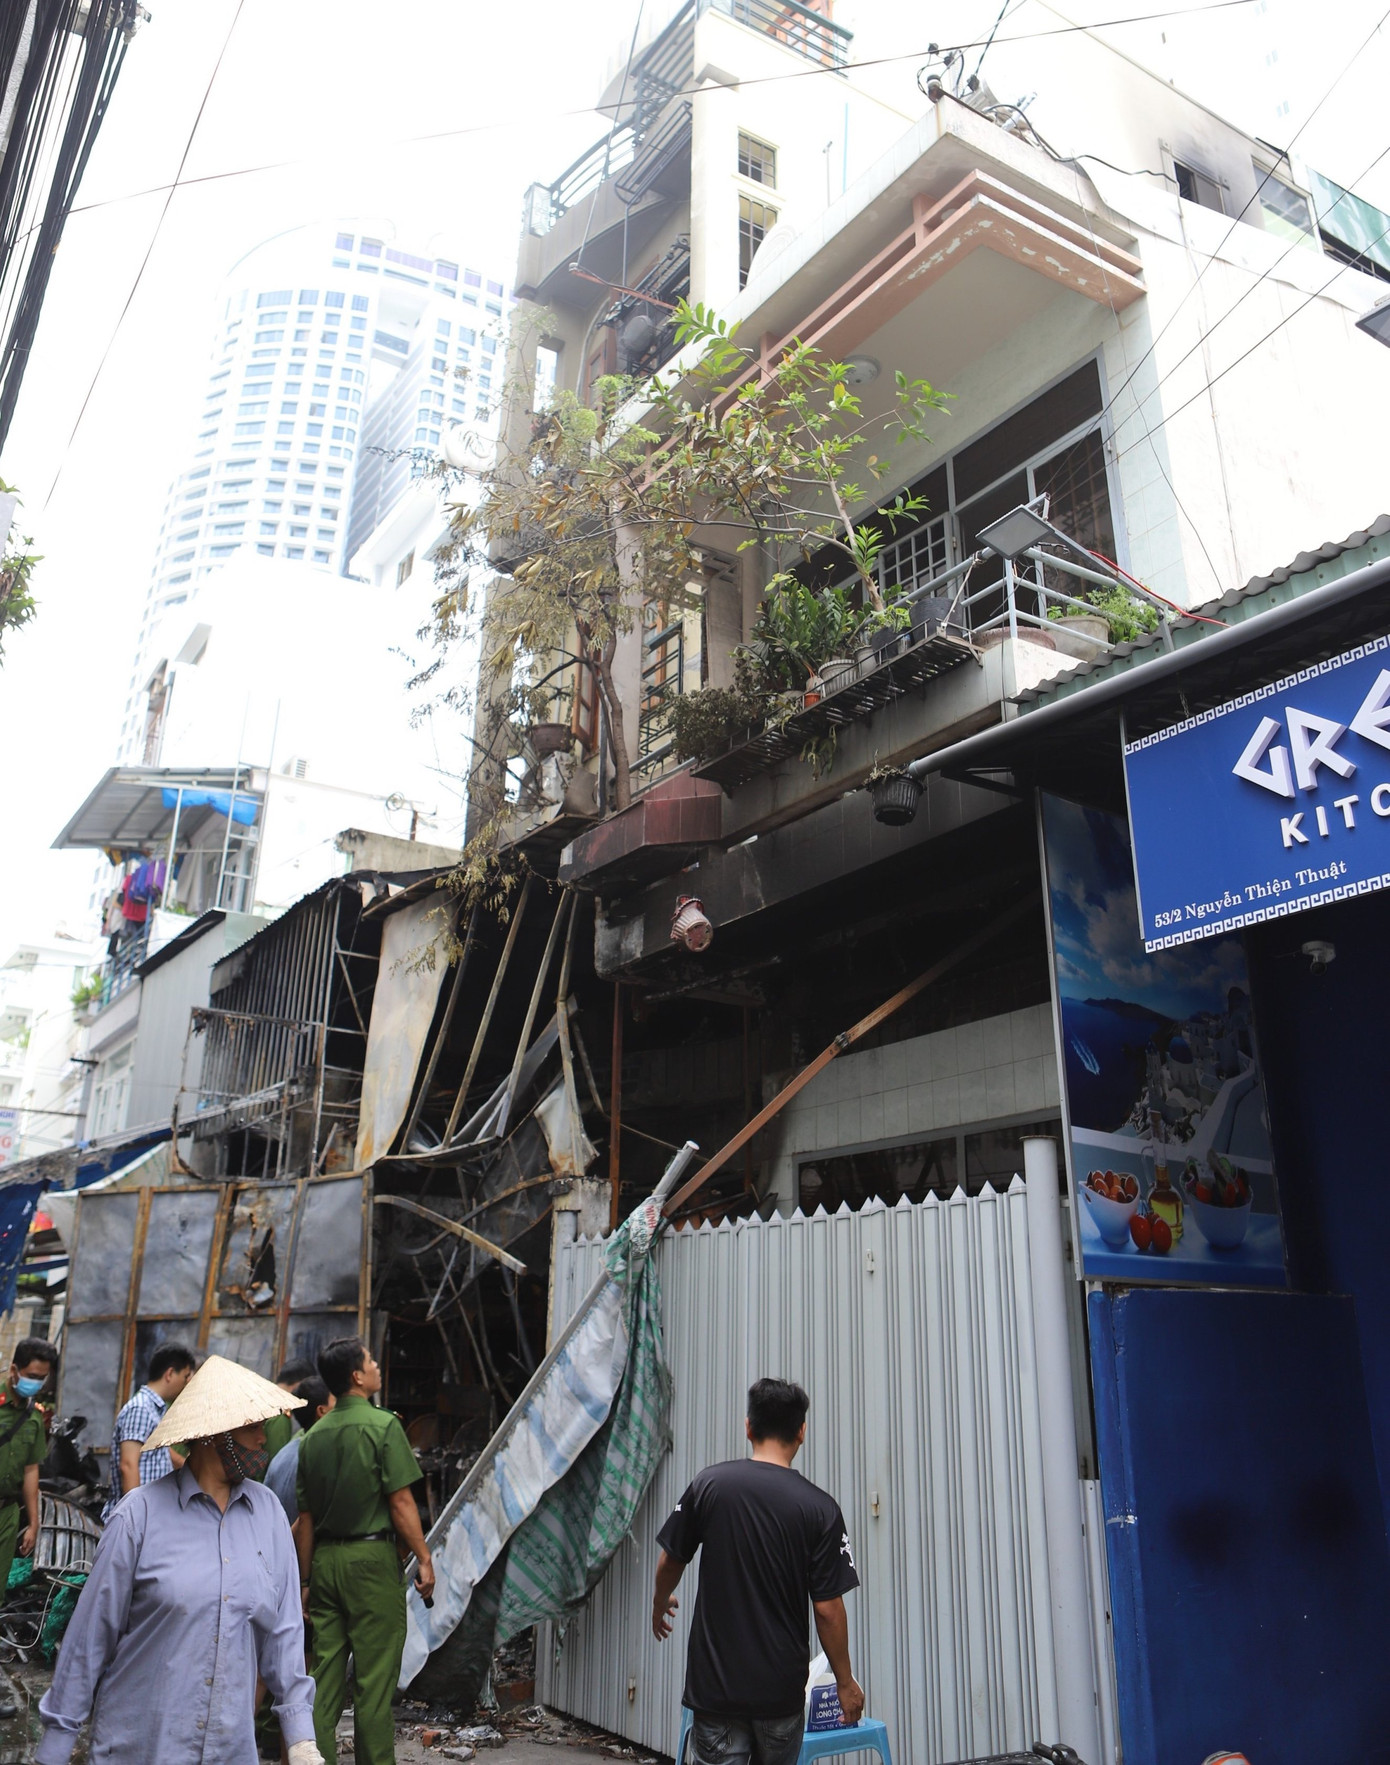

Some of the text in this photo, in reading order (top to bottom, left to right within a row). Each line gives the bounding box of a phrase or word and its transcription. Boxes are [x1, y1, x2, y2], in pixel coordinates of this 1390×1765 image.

[1280, 783, 1390, 848] KITC
[1154, 860, 1347, 929] 53/2 Nguyễn Thiện Thuật
